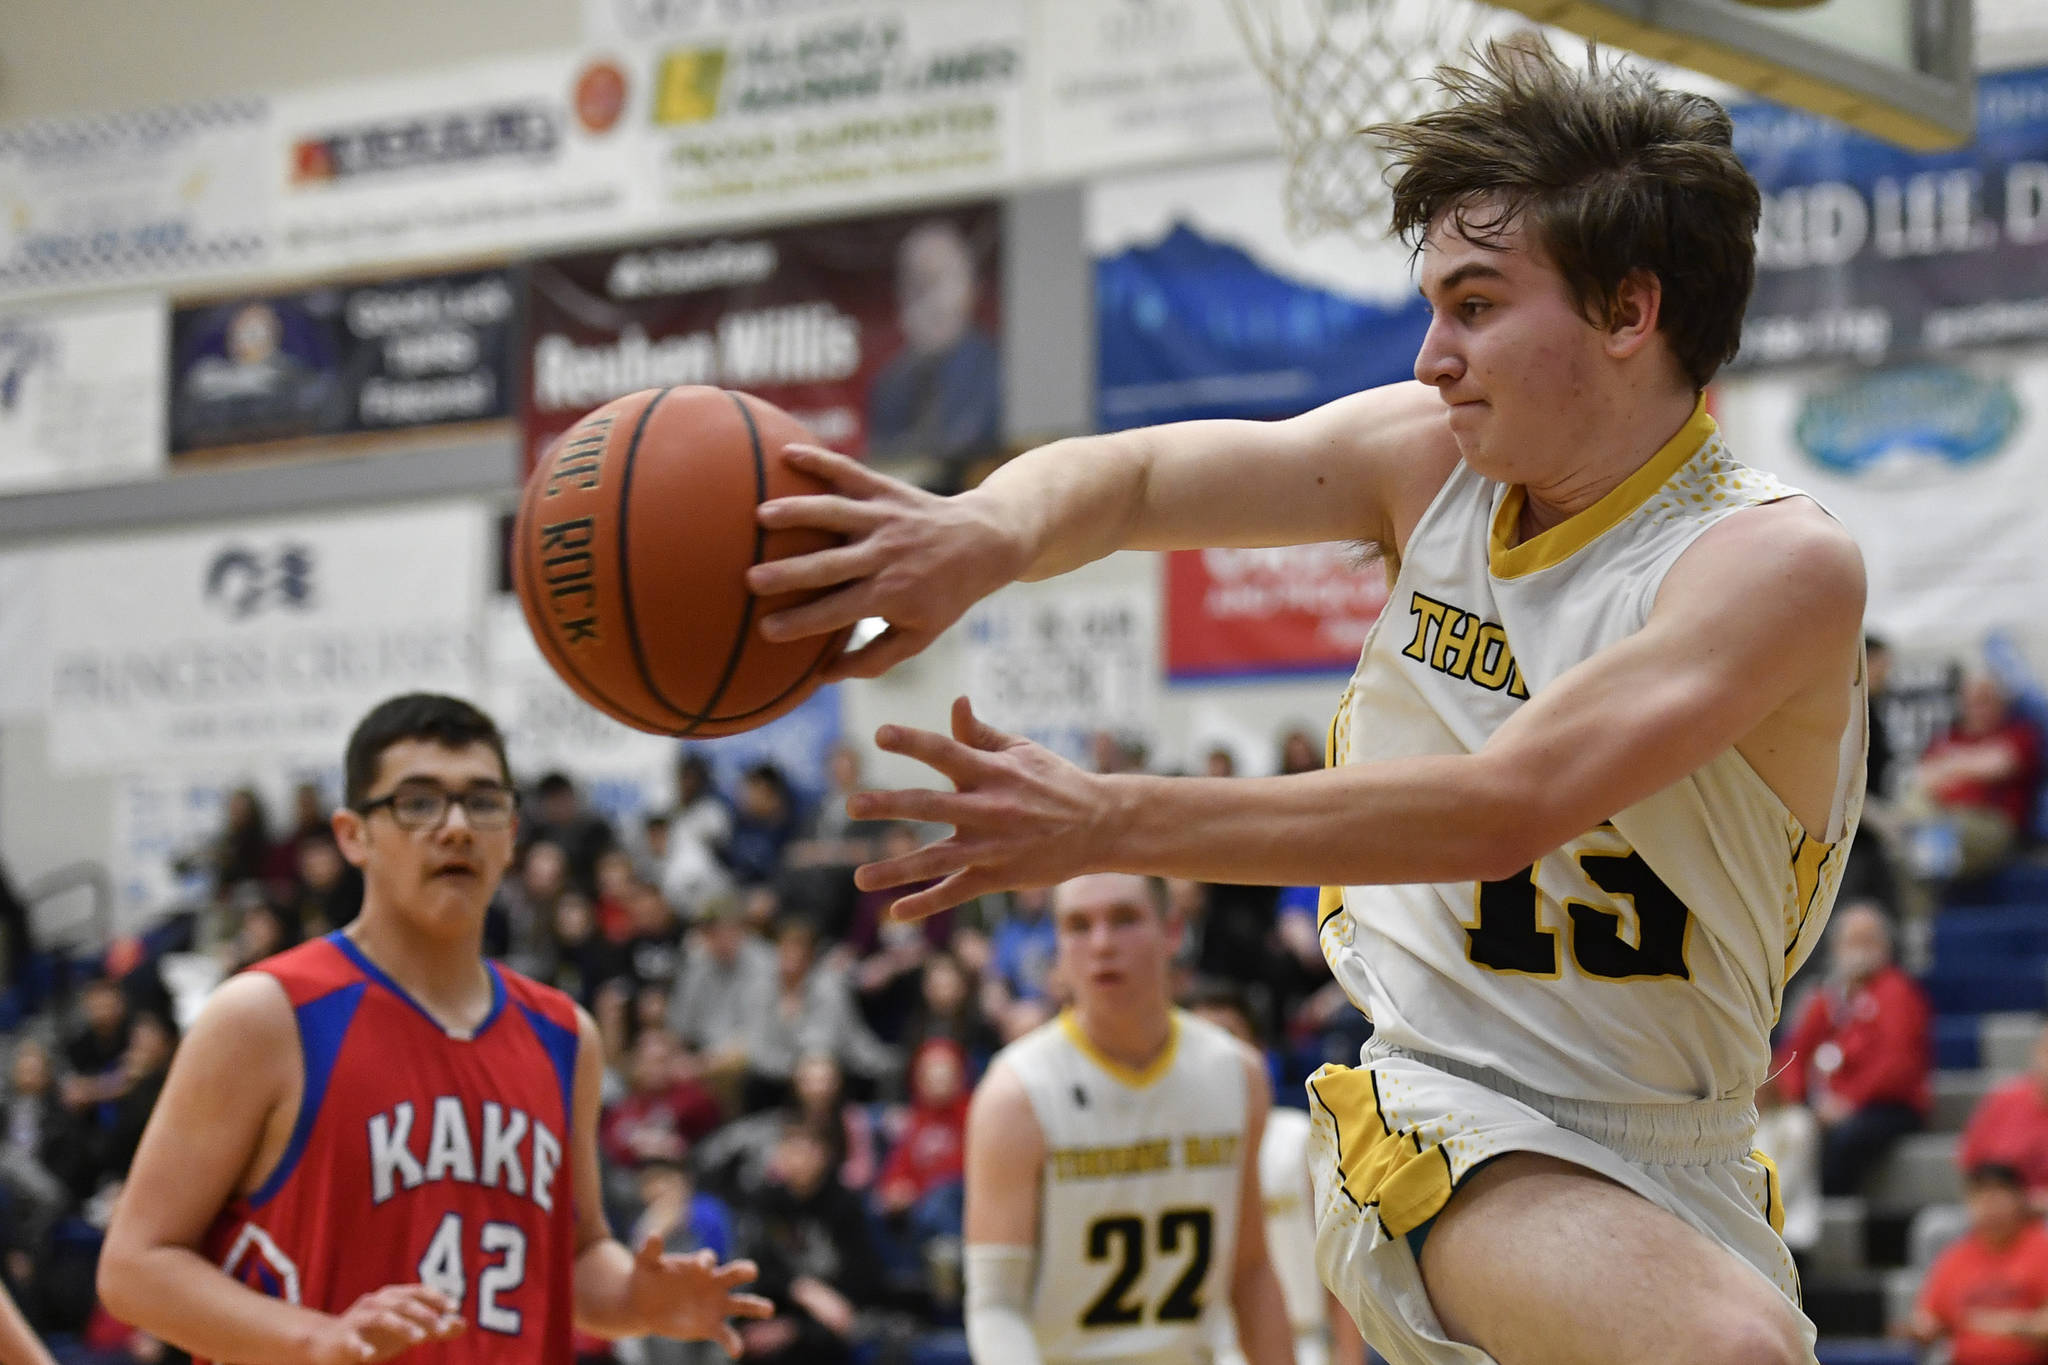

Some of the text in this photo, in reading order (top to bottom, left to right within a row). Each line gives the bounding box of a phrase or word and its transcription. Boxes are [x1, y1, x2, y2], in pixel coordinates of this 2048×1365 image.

[534, 324, 711, 408] Reuben
[717, 301, 862, 386] Willis
[540, 516, 599, 644] ROCK
[368, 1094, 562, 1213] KAKE
[418, 1212, 528, 1338] 42
[1081, 1207, 1213, 1327] 22
